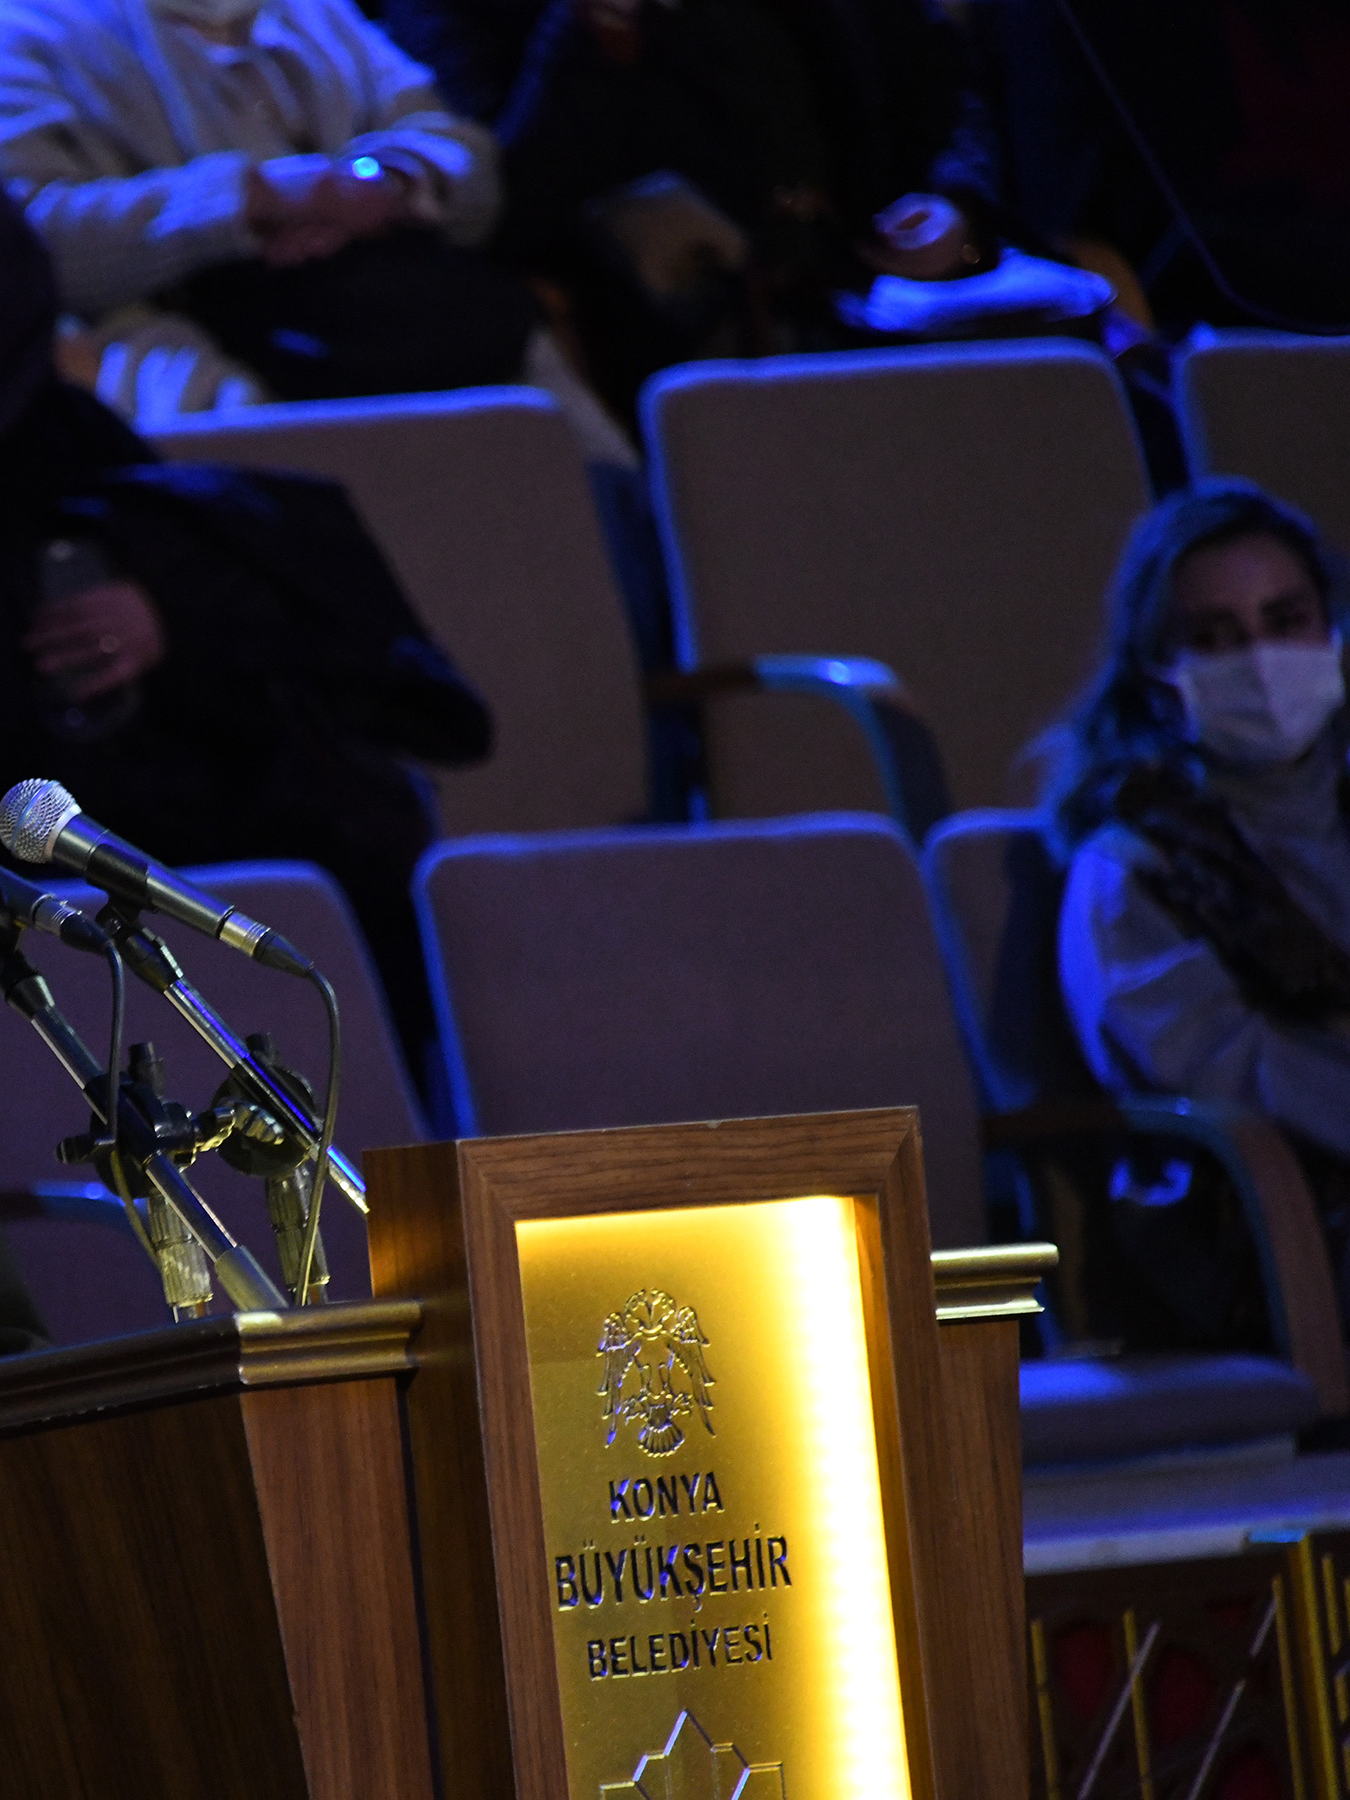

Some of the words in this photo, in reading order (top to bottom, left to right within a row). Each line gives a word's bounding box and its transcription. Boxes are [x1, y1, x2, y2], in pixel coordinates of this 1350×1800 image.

[608, 1472, 725, 1523] KONYA
[556, 1523, 792, 1612] BÜYÜKŞEHİR
[588, 1613, 773, 1681] BELEDİYESİ
